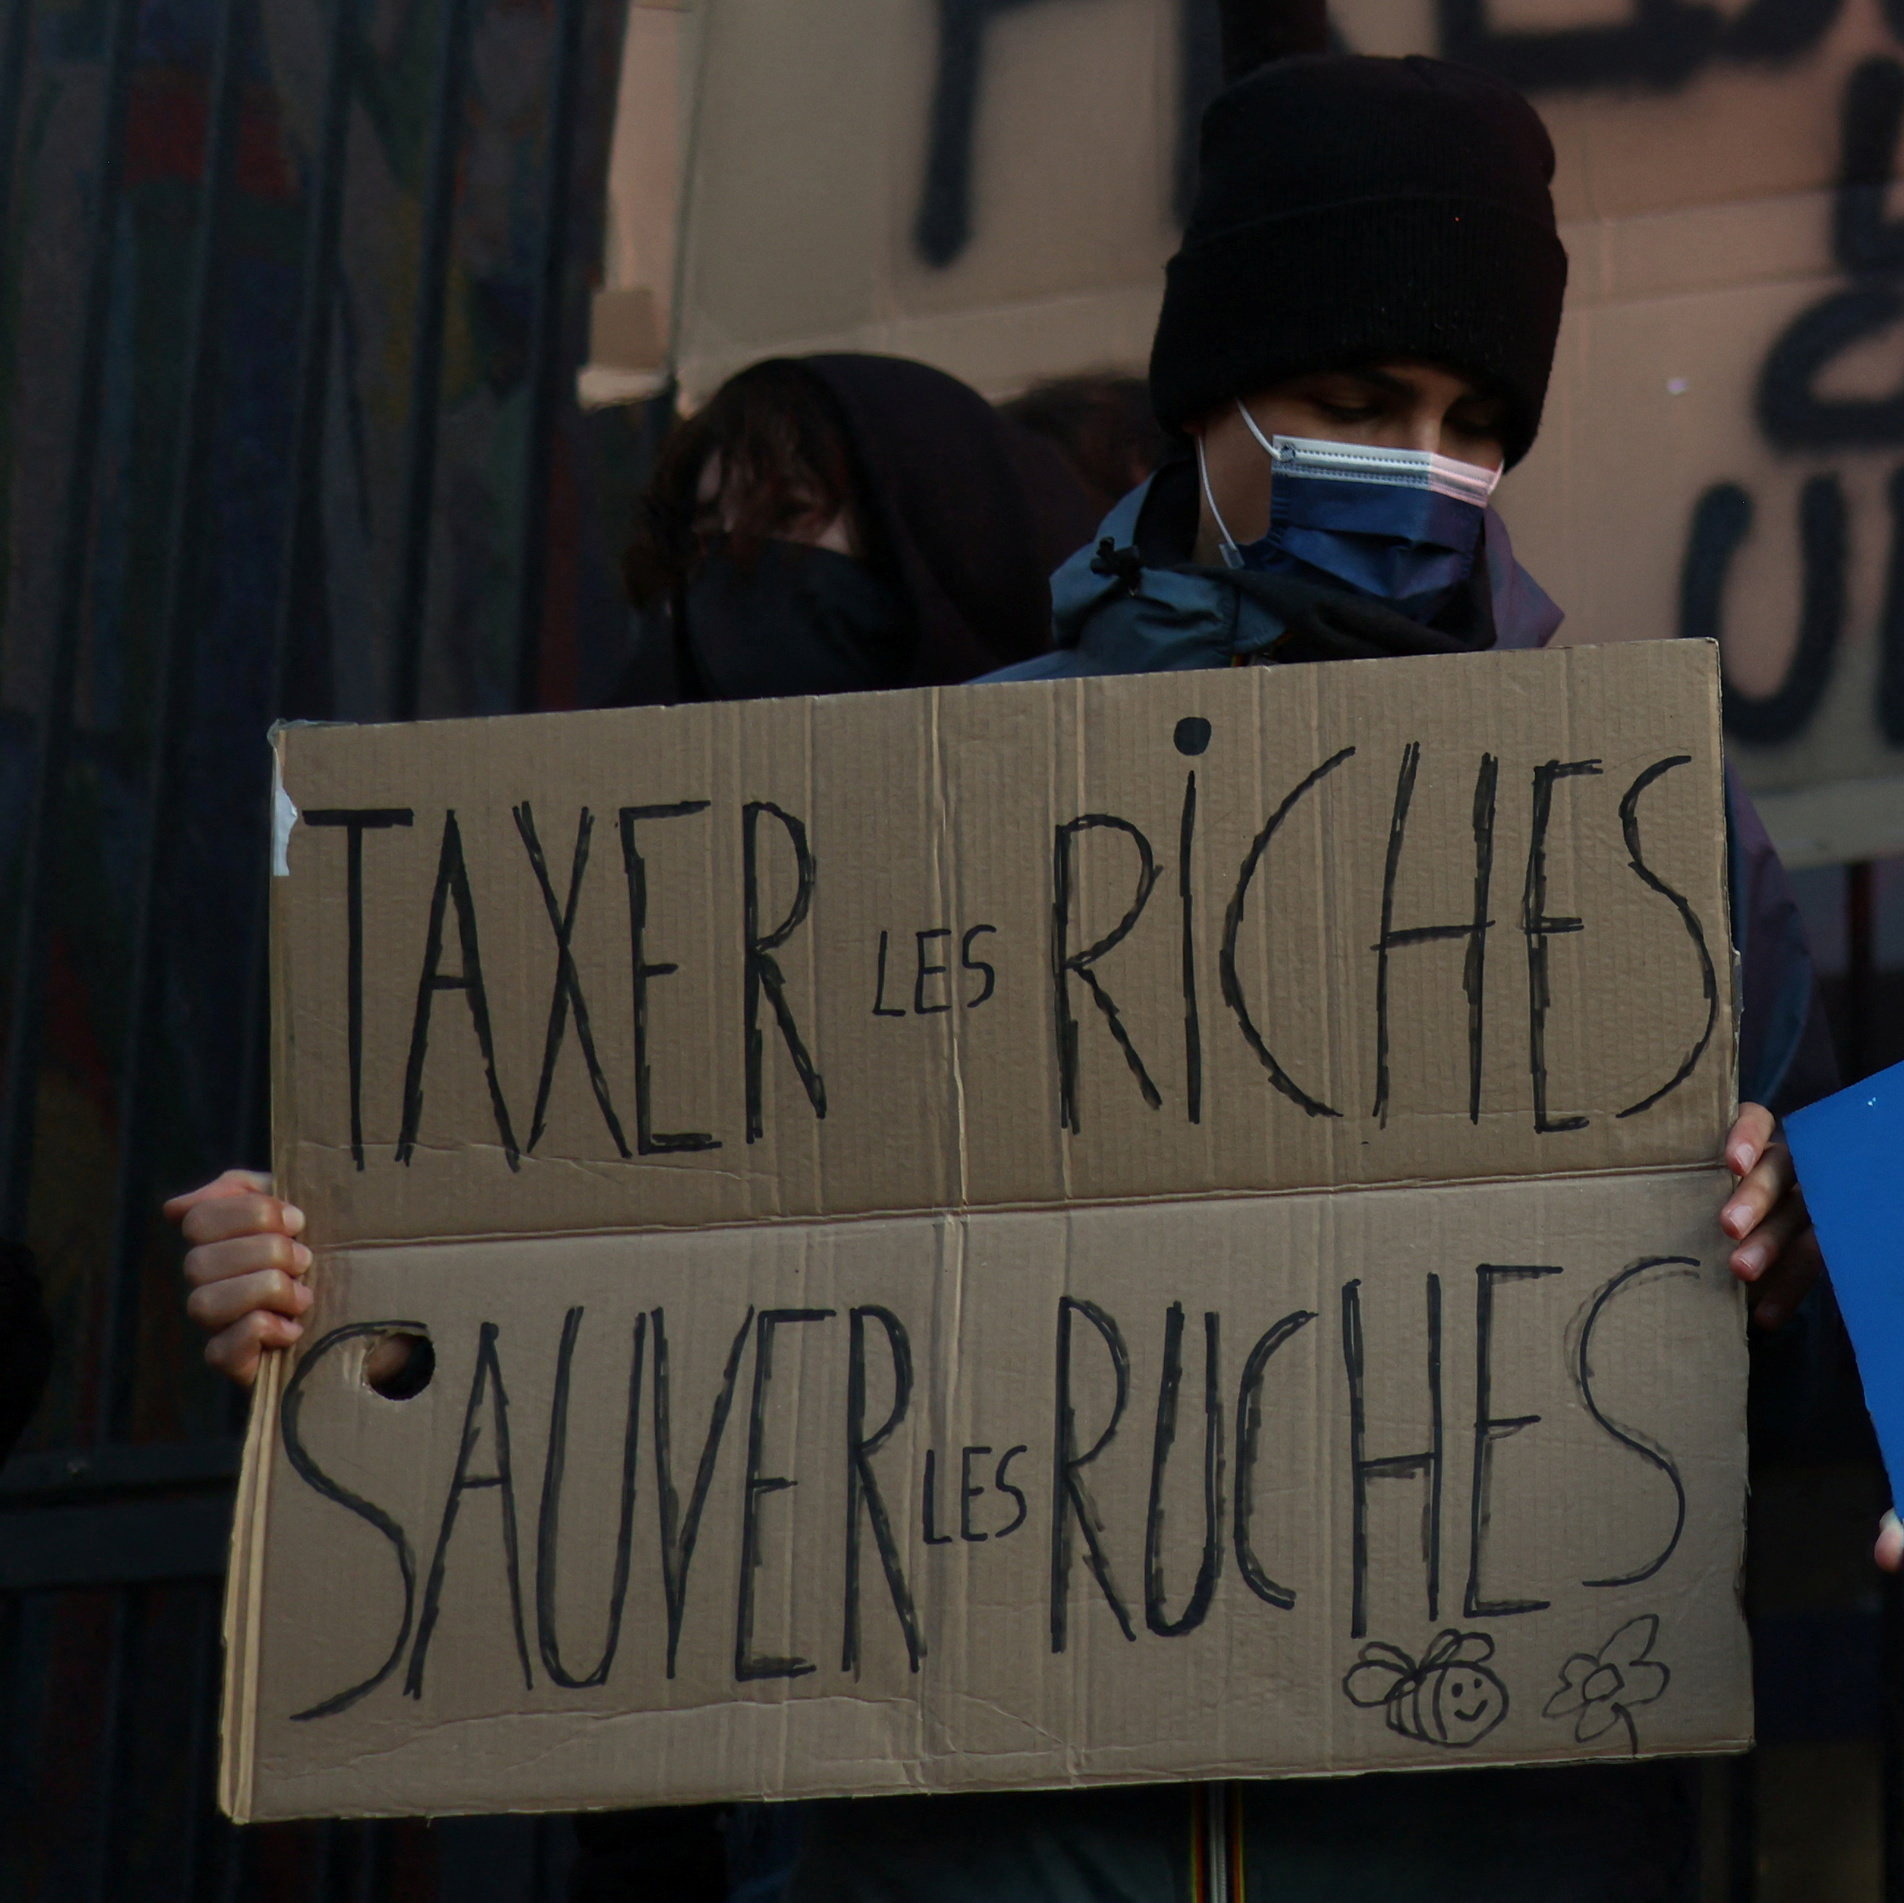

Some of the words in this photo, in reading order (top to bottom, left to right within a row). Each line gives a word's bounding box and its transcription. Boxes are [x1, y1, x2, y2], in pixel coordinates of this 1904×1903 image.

[301, 798, 828, 1172] TAXER
[870, 923, 998, 1019] LES
[279, 1301, 927, 1724] SAUVER
[922, 1443, 1030, 1546] LES
[1049, 1255, 1703, 1656] RUCHES
